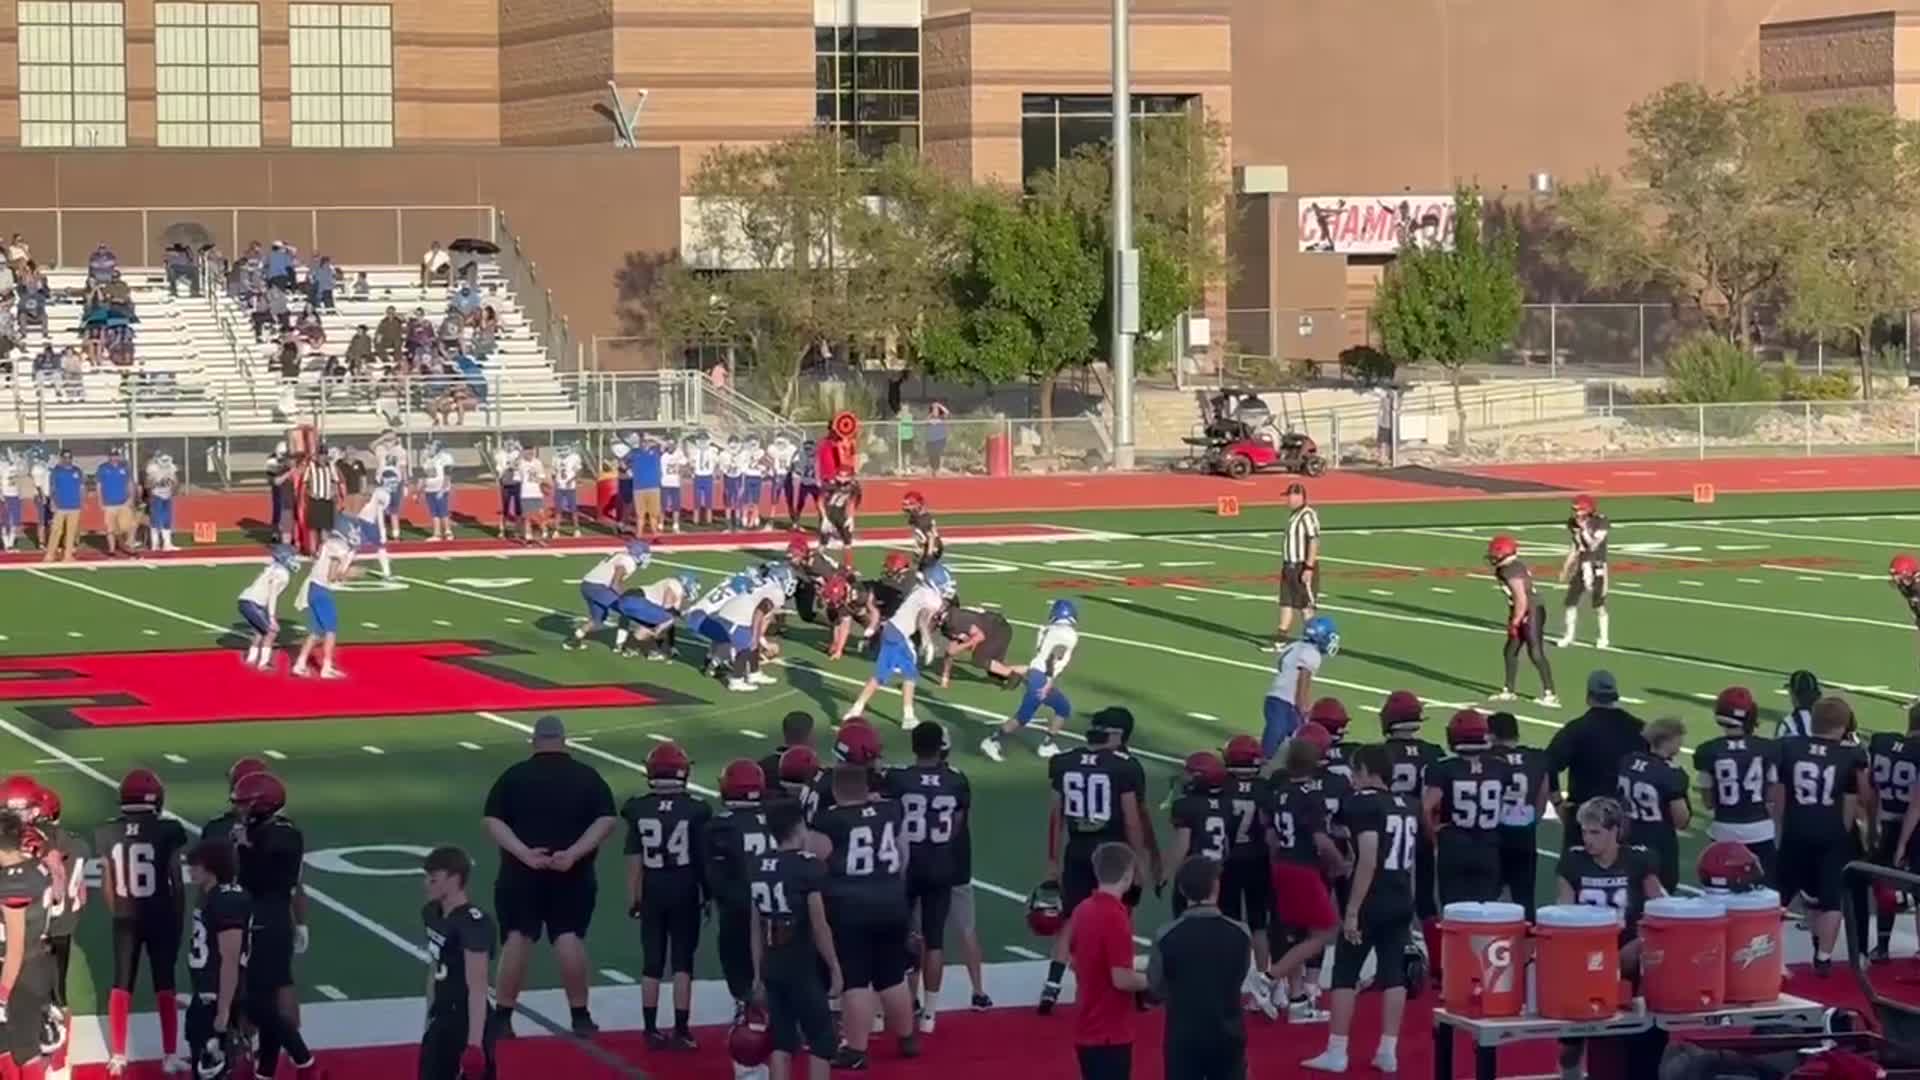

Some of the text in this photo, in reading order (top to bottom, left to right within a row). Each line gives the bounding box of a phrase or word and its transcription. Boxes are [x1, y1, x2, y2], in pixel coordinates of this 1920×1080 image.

[1063, 772, 1112, 821] 60
[1451, 780, 1503, 829] 59
[1714, 757, 1763, 805] 84
[1793, 761, 1836, 805] 61
[901, 793, 958, 843] 83
[638, 818, 690, 868] 24
[846, 822, 900, 875] 64
[111, 842, 156, 898] 16
[1487, 939, 1512, 966] G
